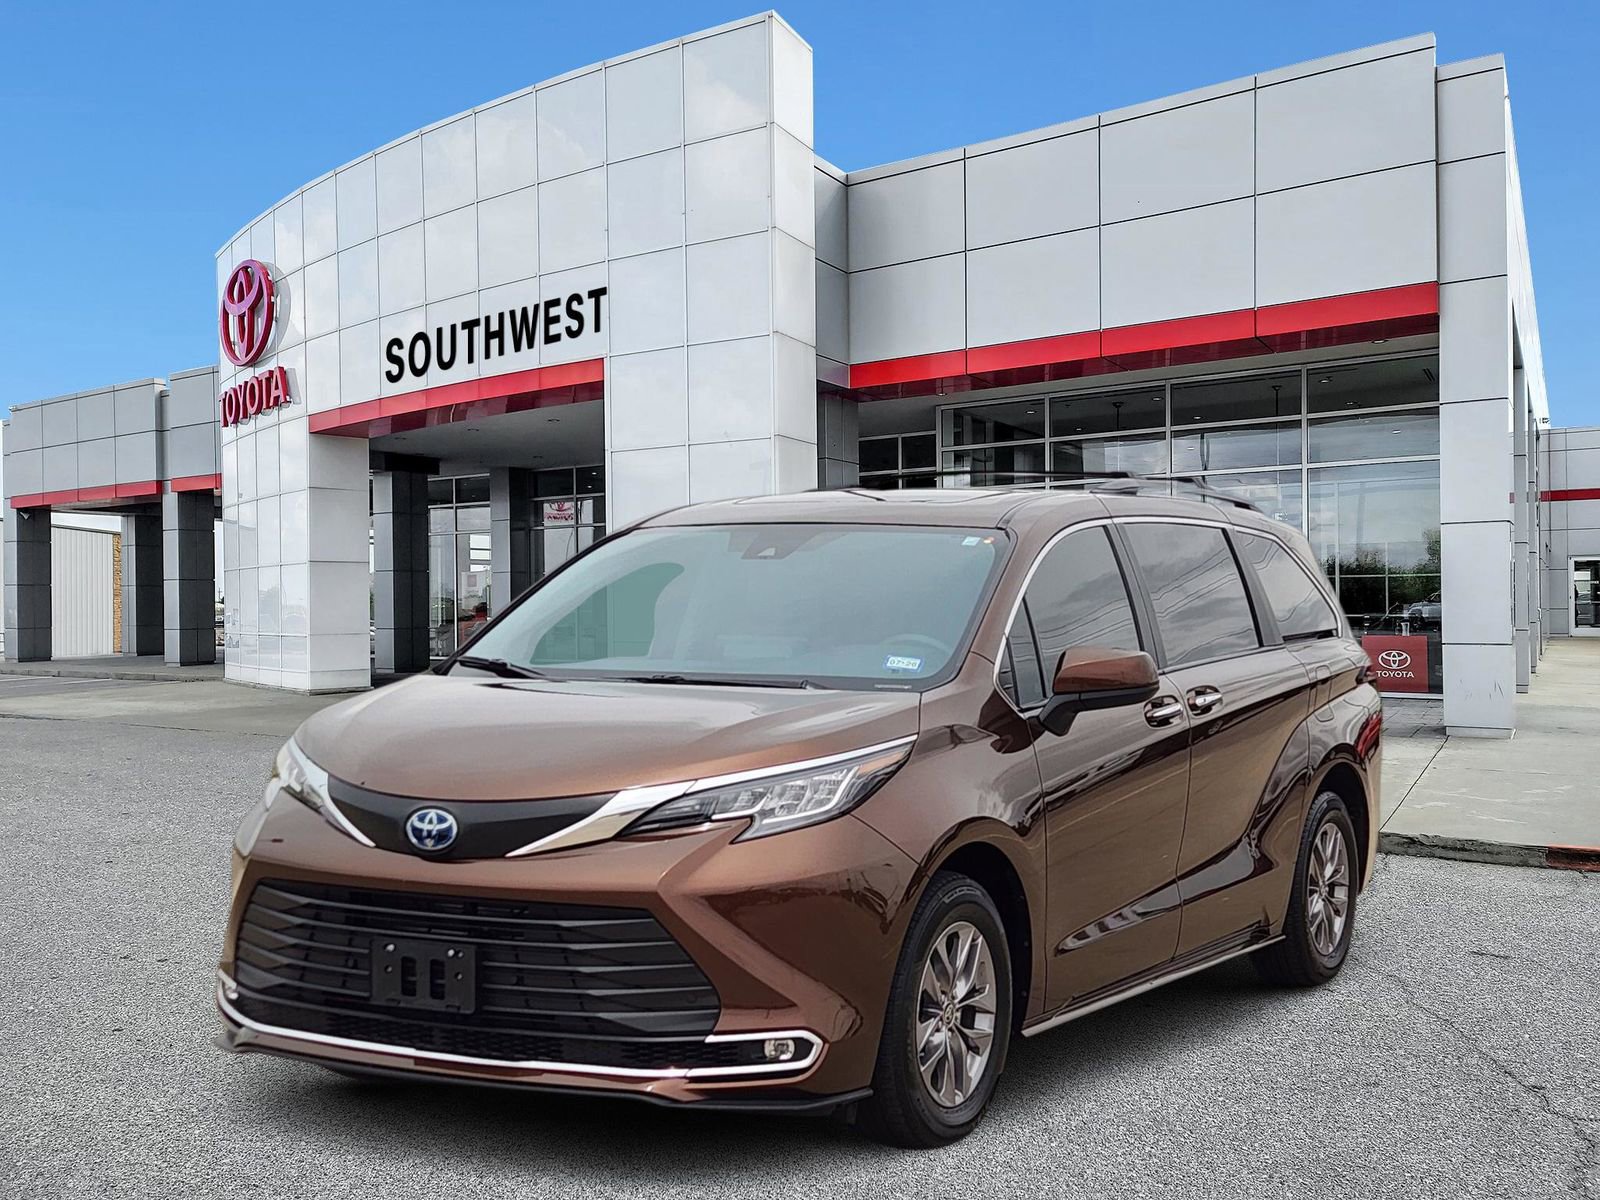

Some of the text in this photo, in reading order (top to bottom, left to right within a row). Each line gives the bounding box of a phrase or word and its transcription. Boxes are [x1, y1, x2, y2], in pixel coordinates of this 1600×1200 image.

[385, 287, 607, 383] SOUTHWEST
[219, 366, 289, 427] TOYOTA
[1376, 670, 1415, 678] TOYOTA
